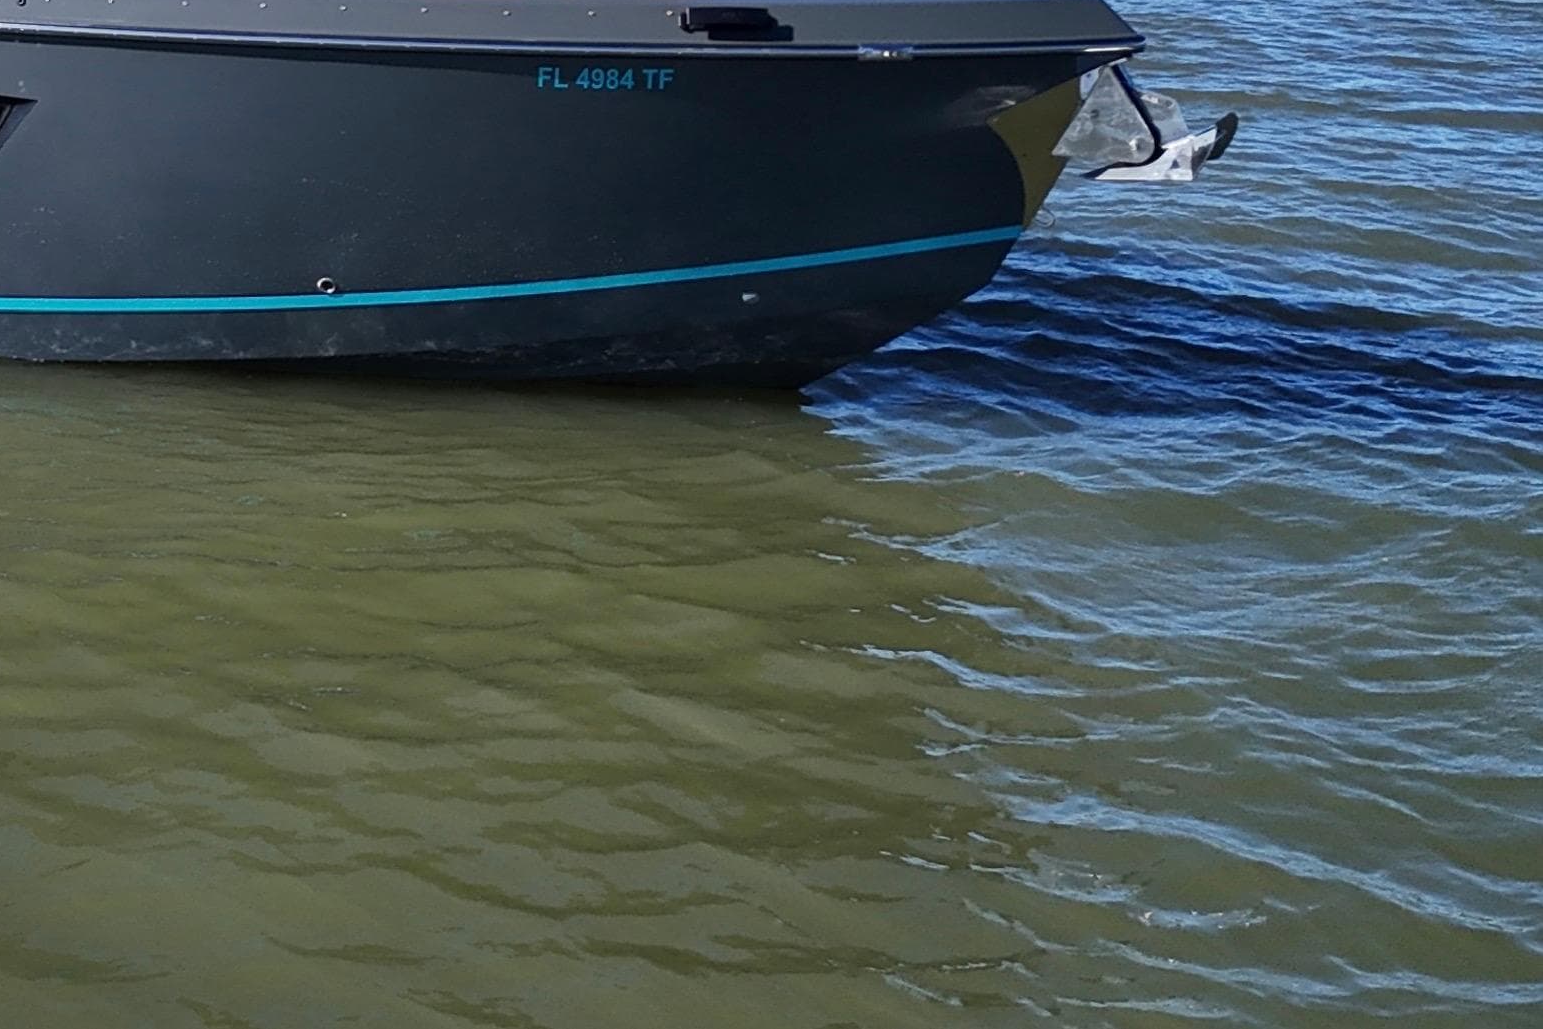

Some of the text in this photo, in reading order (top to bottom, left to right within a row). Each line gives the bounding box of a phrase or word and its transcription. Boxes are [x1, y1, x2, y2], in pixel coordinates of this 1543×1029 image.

[537, 67, 675, 90] FL 4984 TF
